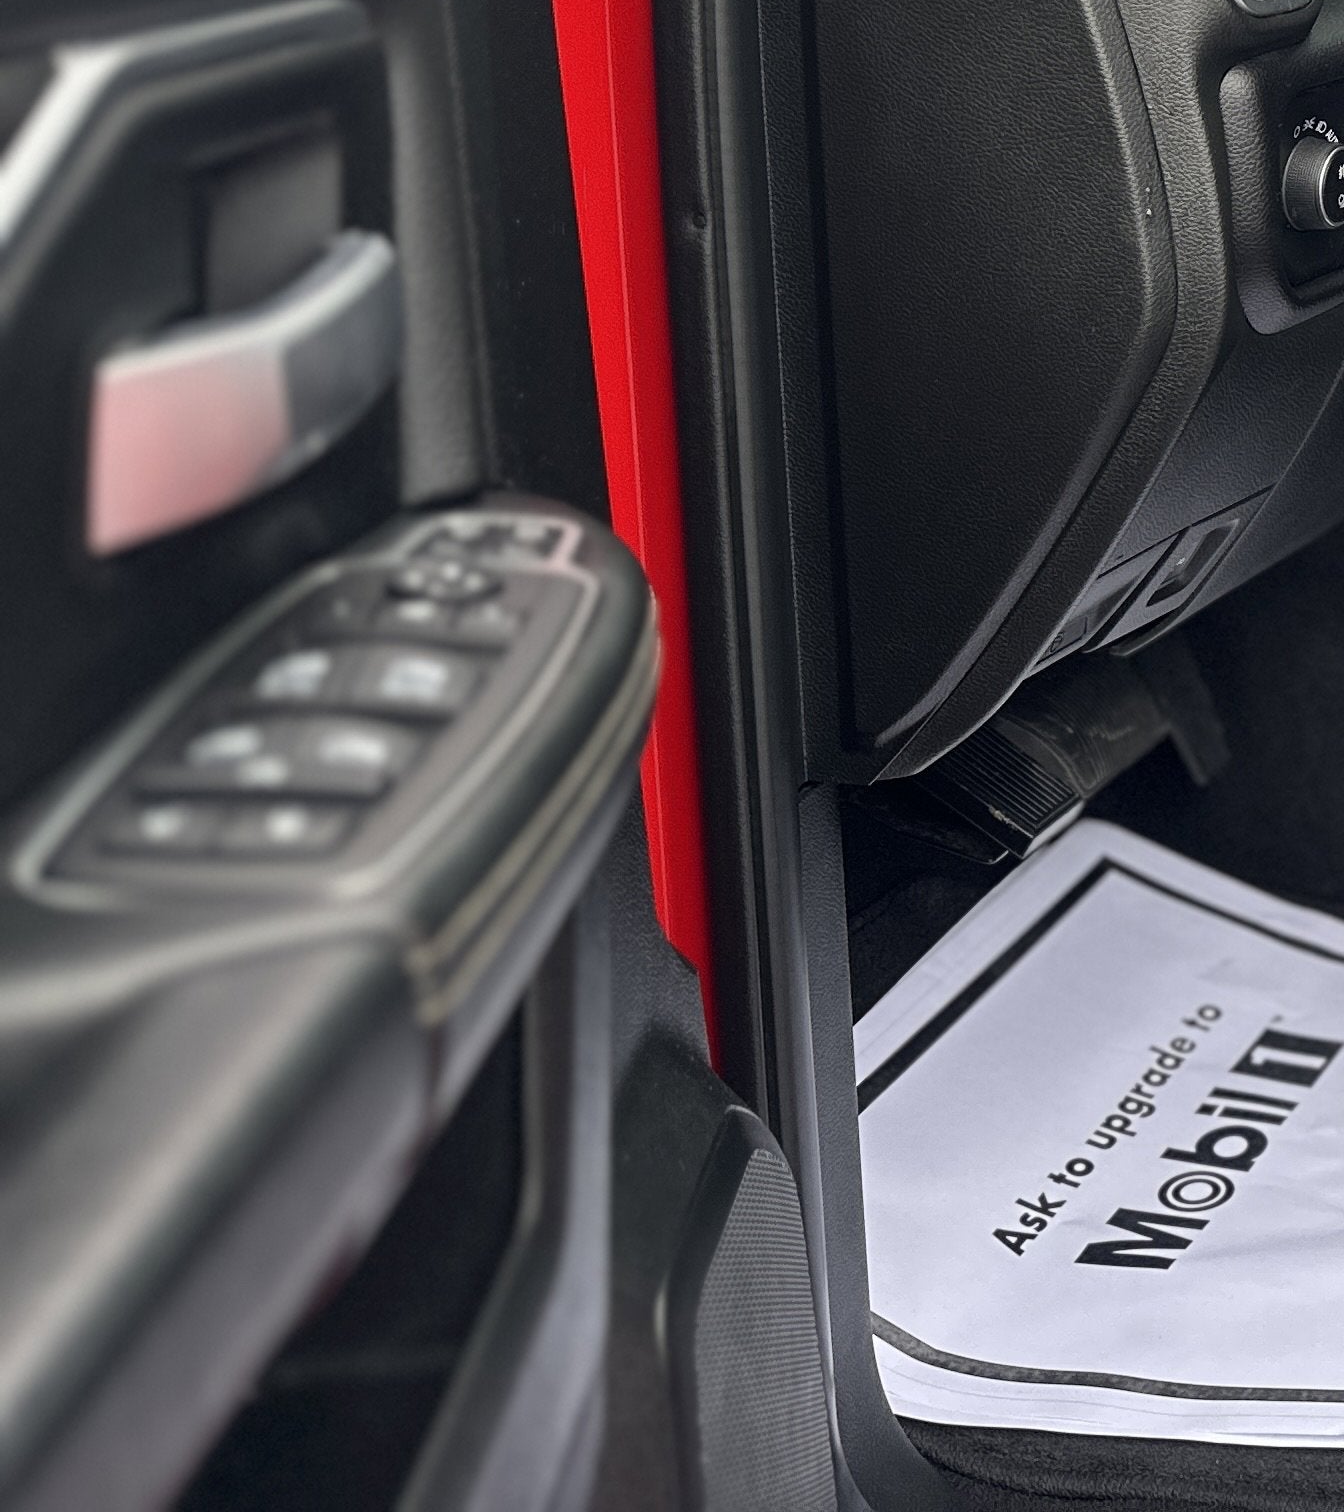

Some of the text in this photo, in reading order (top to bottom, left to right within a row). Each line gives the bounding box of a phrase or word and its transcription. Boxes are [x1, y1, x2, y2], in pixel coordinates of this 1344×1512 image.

[992, 1003, 1223, 1257] Ask to upgrade to
[1073, 1086, 1300, 1270] Mobil
